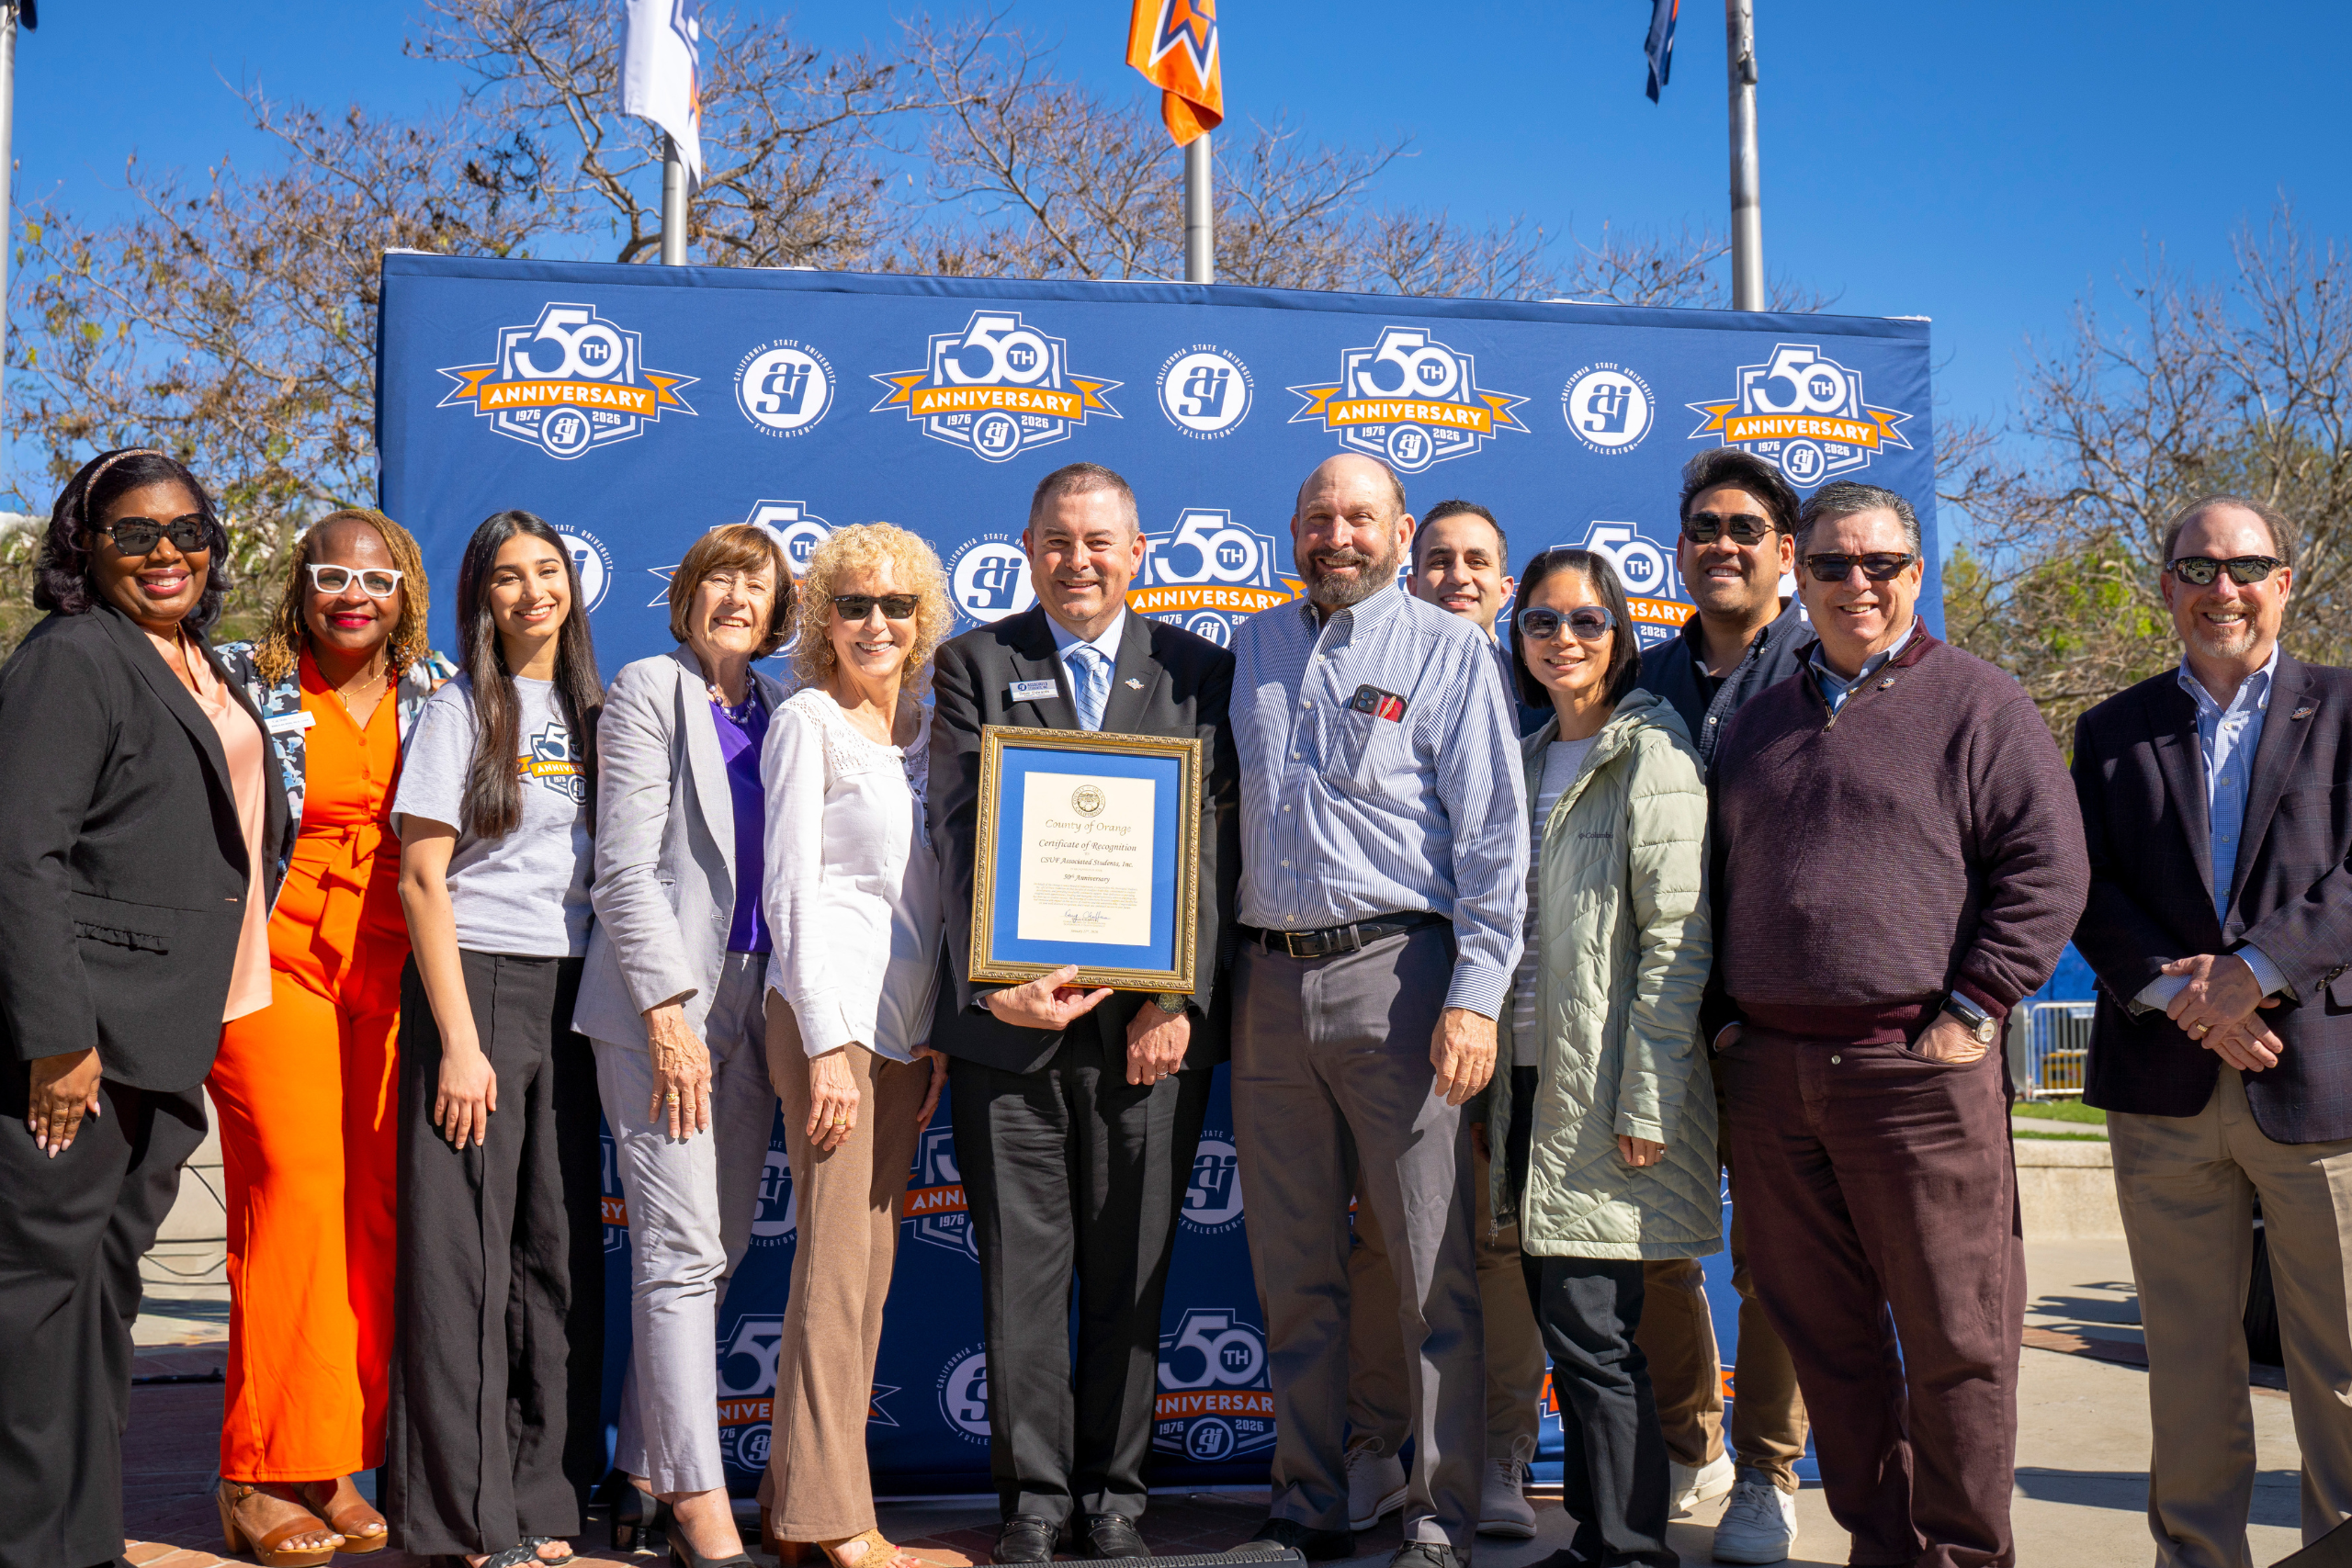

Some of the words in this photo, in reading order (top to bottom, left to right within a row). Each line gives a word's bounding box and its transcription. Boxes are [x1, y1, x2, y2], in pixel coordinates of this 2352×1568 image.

[733, 344, 767, 381] CALIFORNIA
[774, 339, 798, 347] STATE
[805, 344, 837, 384] UNIVERSITY
[1156, 348, 1187, 385] CALIFORNIA
[1193, 344, 1216, 352] STATE
[1223, 349, 1254, 388] UNIVERSITY
[1561, 366, 1590, 401] CALIFORNIA
[1595, 362, 1618, 370] STATE
[1623, 367, 1656, 404] UNIVERSITY
[489, 386, 646, 408] ANNIVERSARY
[921, 390, 1072, 412] ANNIVERSARY
[515, 409, 541, 422] 1976
[592, 411, 621, 424] 2026
[947, 413, 972, 426] 1976
[1021, 415, 1049, 429] 2026
[1336, 403, 1482, 426] ANNIVERSARY
[1362, 425, 1385, 437] 1976
[1432, 428, 1460, 441] 2026
[1734, 419, 1870, 441] ANNIVERSARY
[1758, 441, 1781, 453] 1976
[1824, 443, 1850, 457] 2026
[549, 525, 575, 533] TATE
[581, 529, 614, 570] UNIVERSITY
[945, 537, 978, 576] CALIFORNIA
[983, 533, 1008, 541] STATE
[1132, 590, 1283, 610] ANNIVERSARY
[1640, 625, 1668, 638] 2026
[537, 763, 585, 773] ANNIVER
[553, 775, 567, 784] 1976
[1046, 819, 1081, 833] County
[1084, 820, 1096, 834] of
[1096, 822, 1132, 836] Orange
[1038, 839, 1080, 850] Certificate
[1080, 840, 1091, 851] of
[1091, 841, 1137, 852] Recognition
[1060, 857, 1093, 865] Associated
[1092, 859, 1121, 867] Students,
[1074, 874, 1111, 884] Anniversary
[1200, 1130, 1224, 1138] TATE
[939, 1213, 965, 1228] 1976
[750, 1234, 796, 1247] LLERTON
[936, 1347, 971, 1389] CALIFORNIA
[1159, 1420, 1184, 1436] 1976
[1235, 1419, 1264, 1432] 2026
[958, 1431, 989, 1446] FULLE
